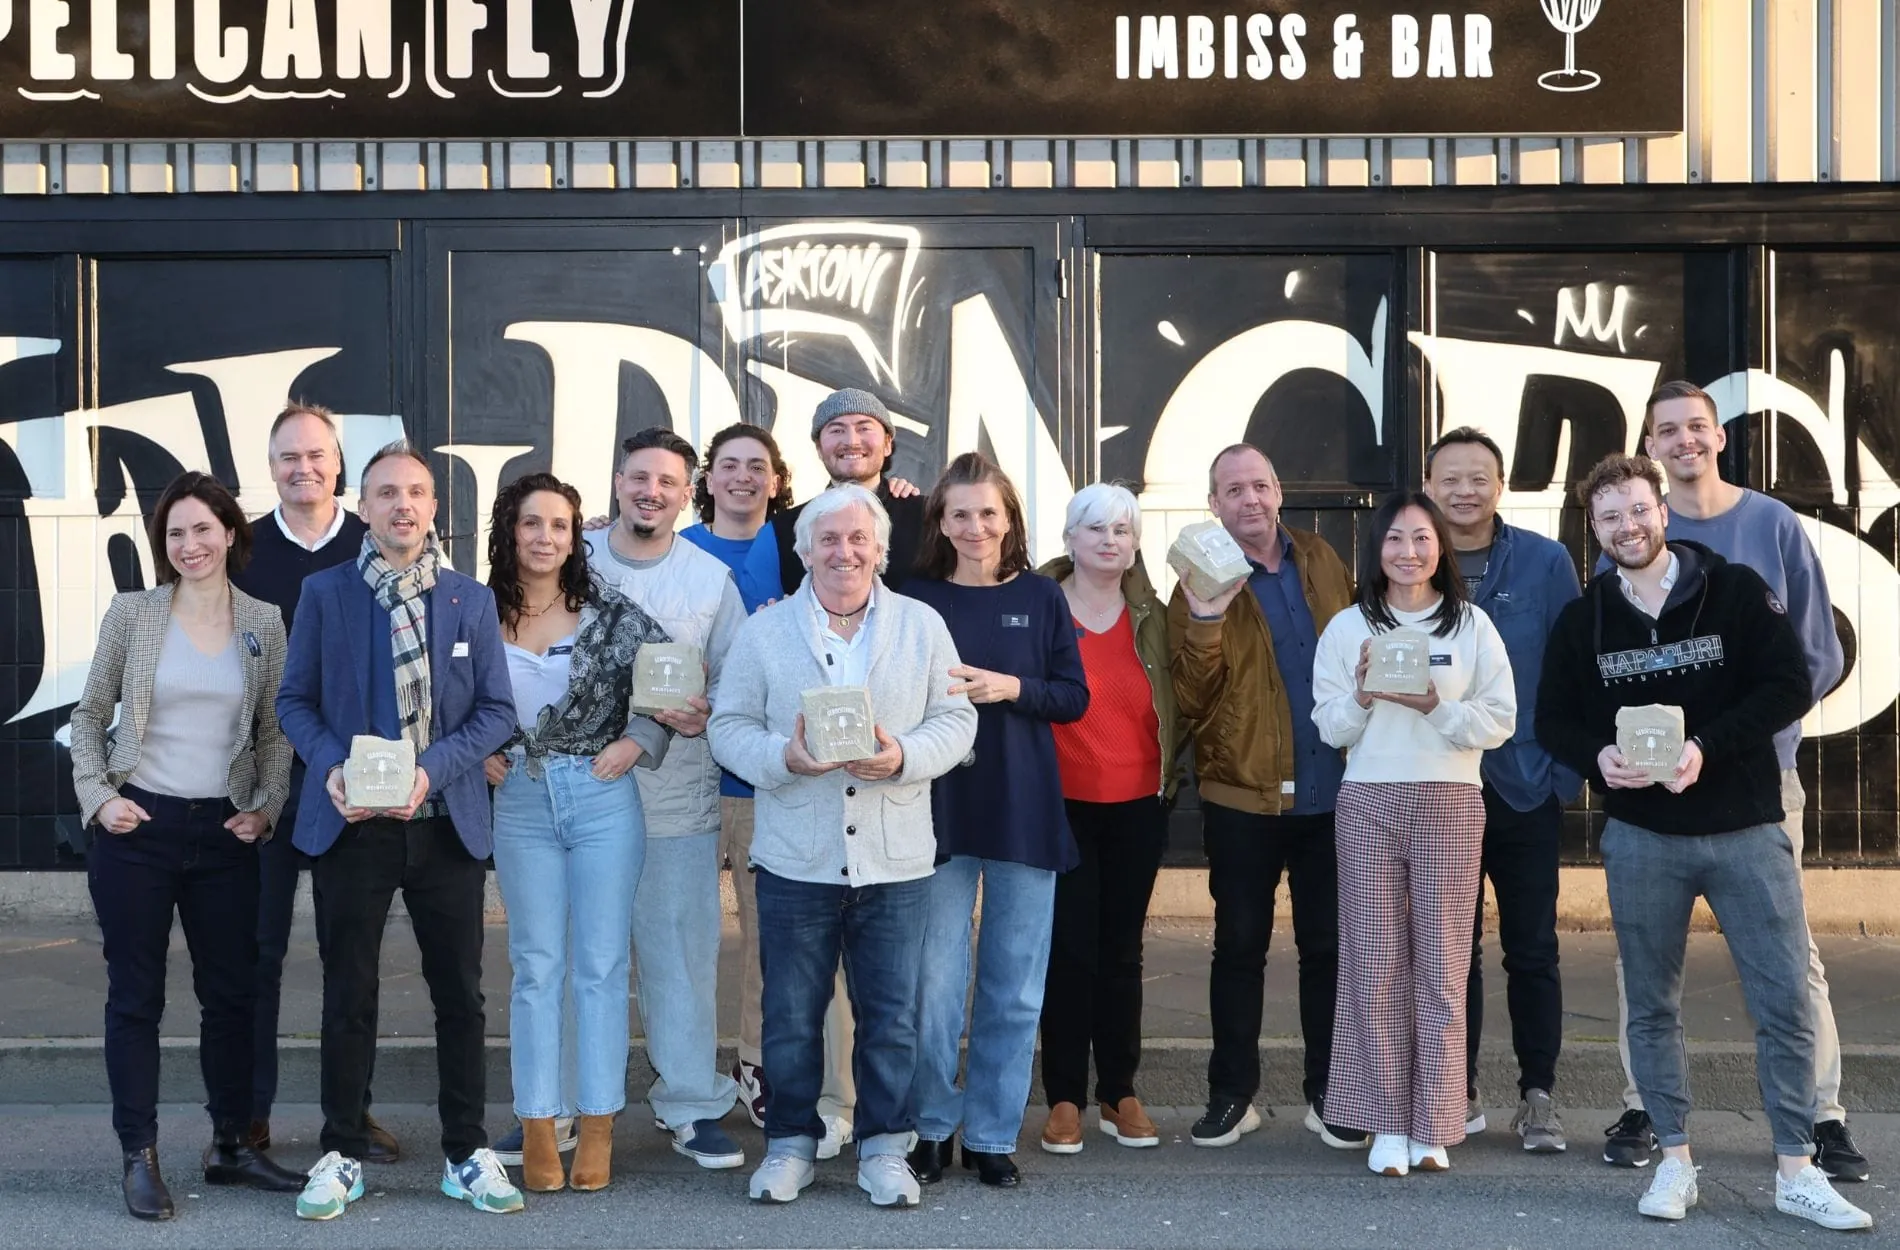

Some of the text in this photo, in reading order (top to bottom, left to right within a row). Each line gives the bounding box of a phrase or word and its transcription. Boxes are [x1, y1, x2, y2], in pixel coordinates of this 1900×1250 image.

[446, 0, 612, 79] FLY
[1115, 13, 1493, 80] IMBISS & BAR
